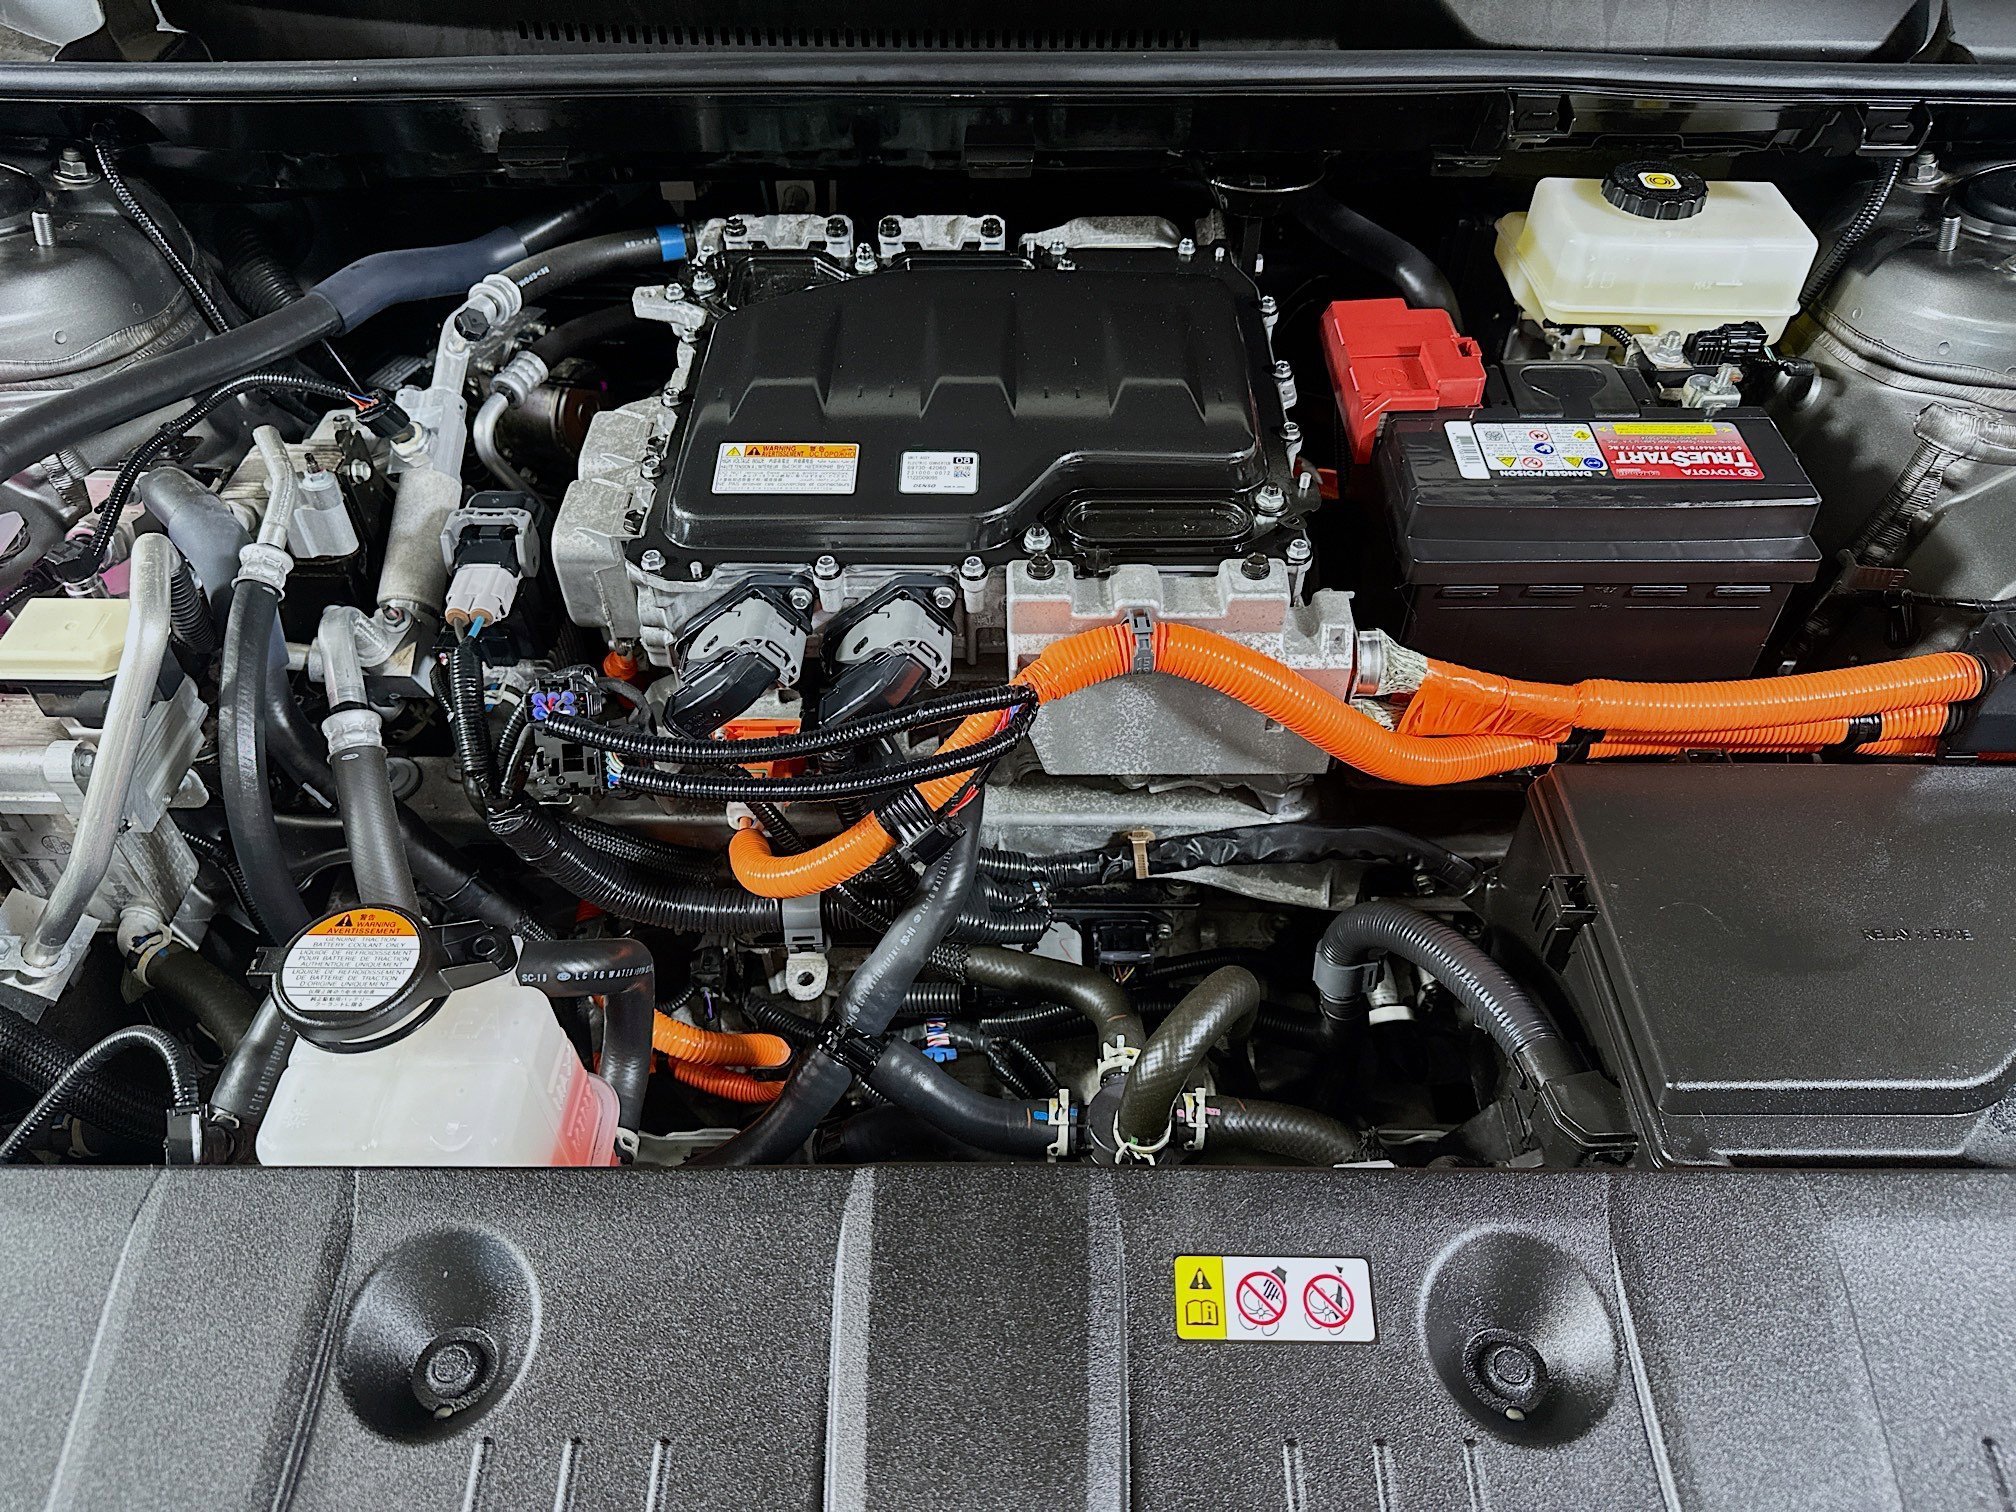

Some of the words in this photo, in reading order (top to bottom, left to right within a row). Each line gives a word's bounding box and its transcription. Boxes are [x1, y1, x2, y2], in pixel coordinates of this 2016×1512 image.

[932, 866, 948, 892] WATER
[360, 913, 376, 921] 警告
[608, 969, 634, 979] WATER
